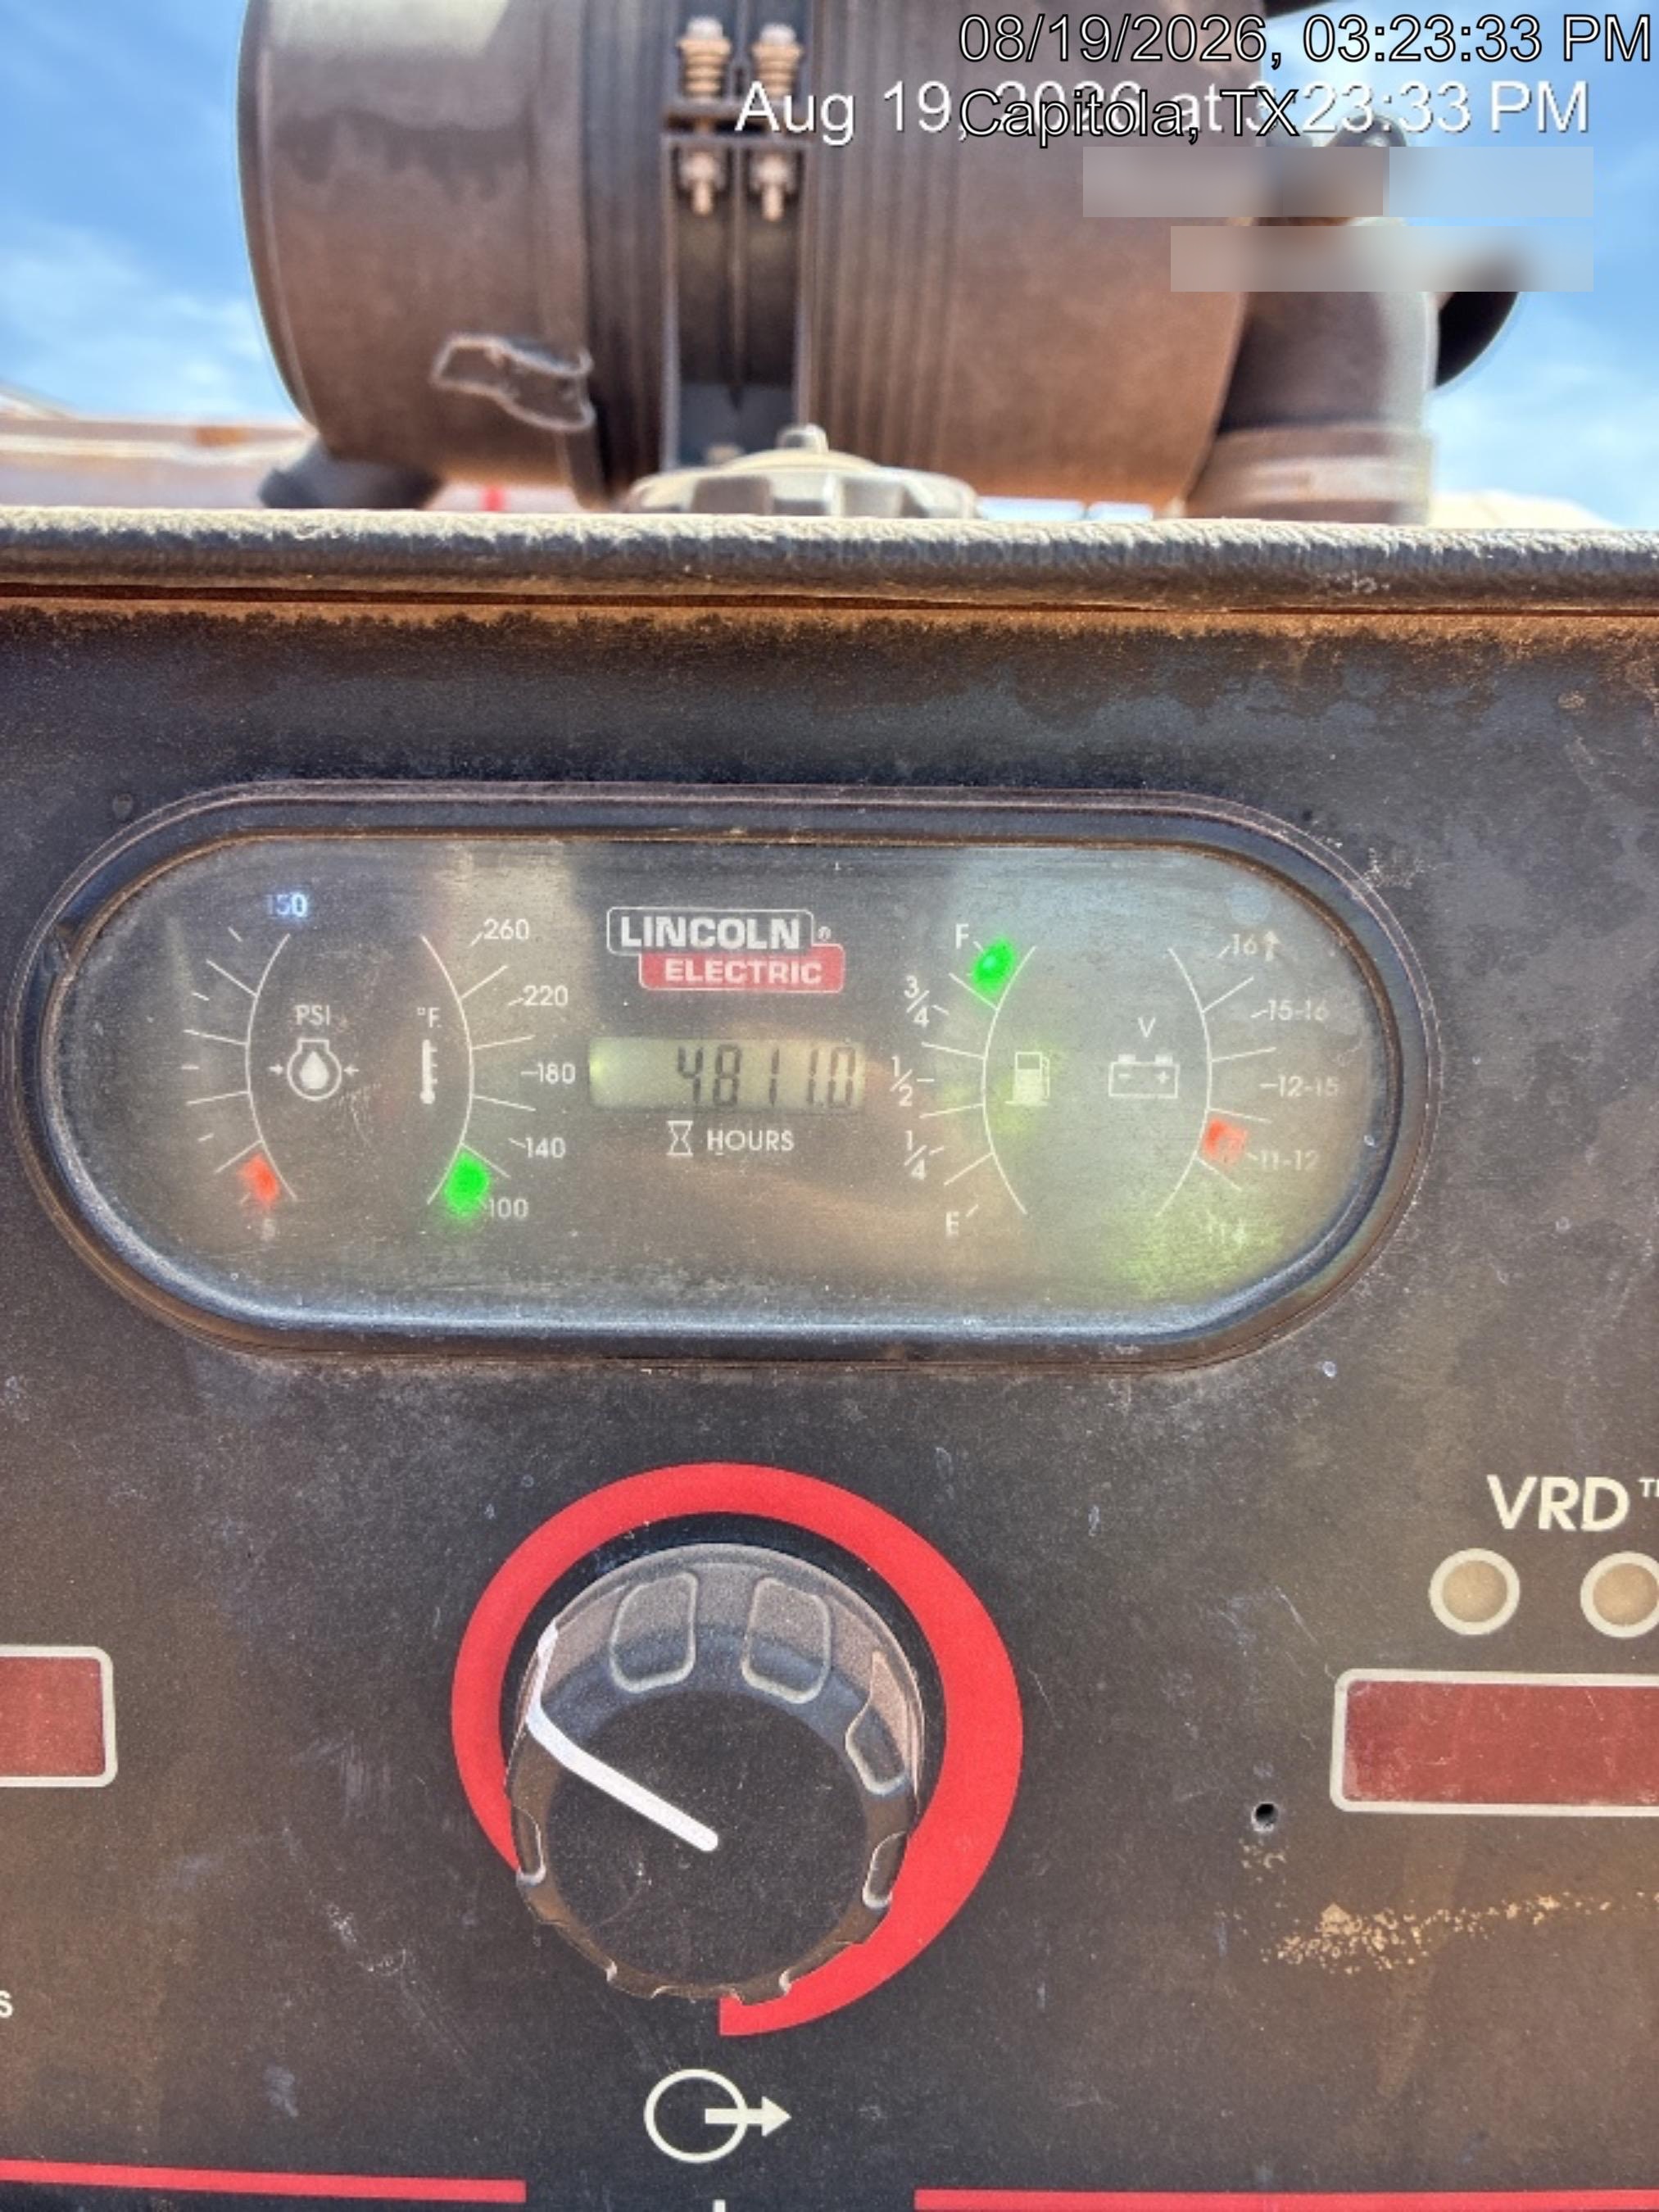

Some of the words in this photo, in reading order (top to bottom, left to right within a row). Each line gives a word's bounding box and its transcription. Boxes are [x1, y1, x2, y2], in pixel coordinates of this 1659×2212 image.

[267, 891, 309, 918] 150
[483, 919, 529, 941] 260
[619, 915, 800, 950] LINCOLN
[955, 923, 969, 949] F
[664, 958, 823, 985] ELECTRIC
[523, 986, 569, 1007] 220
[295, 1005, 331, 1027] PSI
[1137, 1017, 1156, 1038] V
[538, 1063, 576, 1085] 180
[524, 1137, 567, 1158] 140
[706, 1129, 796, 1152] HOURS
[487, 1199, 529, 1219] 100
[1486, 1474, 1630, 1532] VRD
[1639, 1477, 1659, 1498] T
